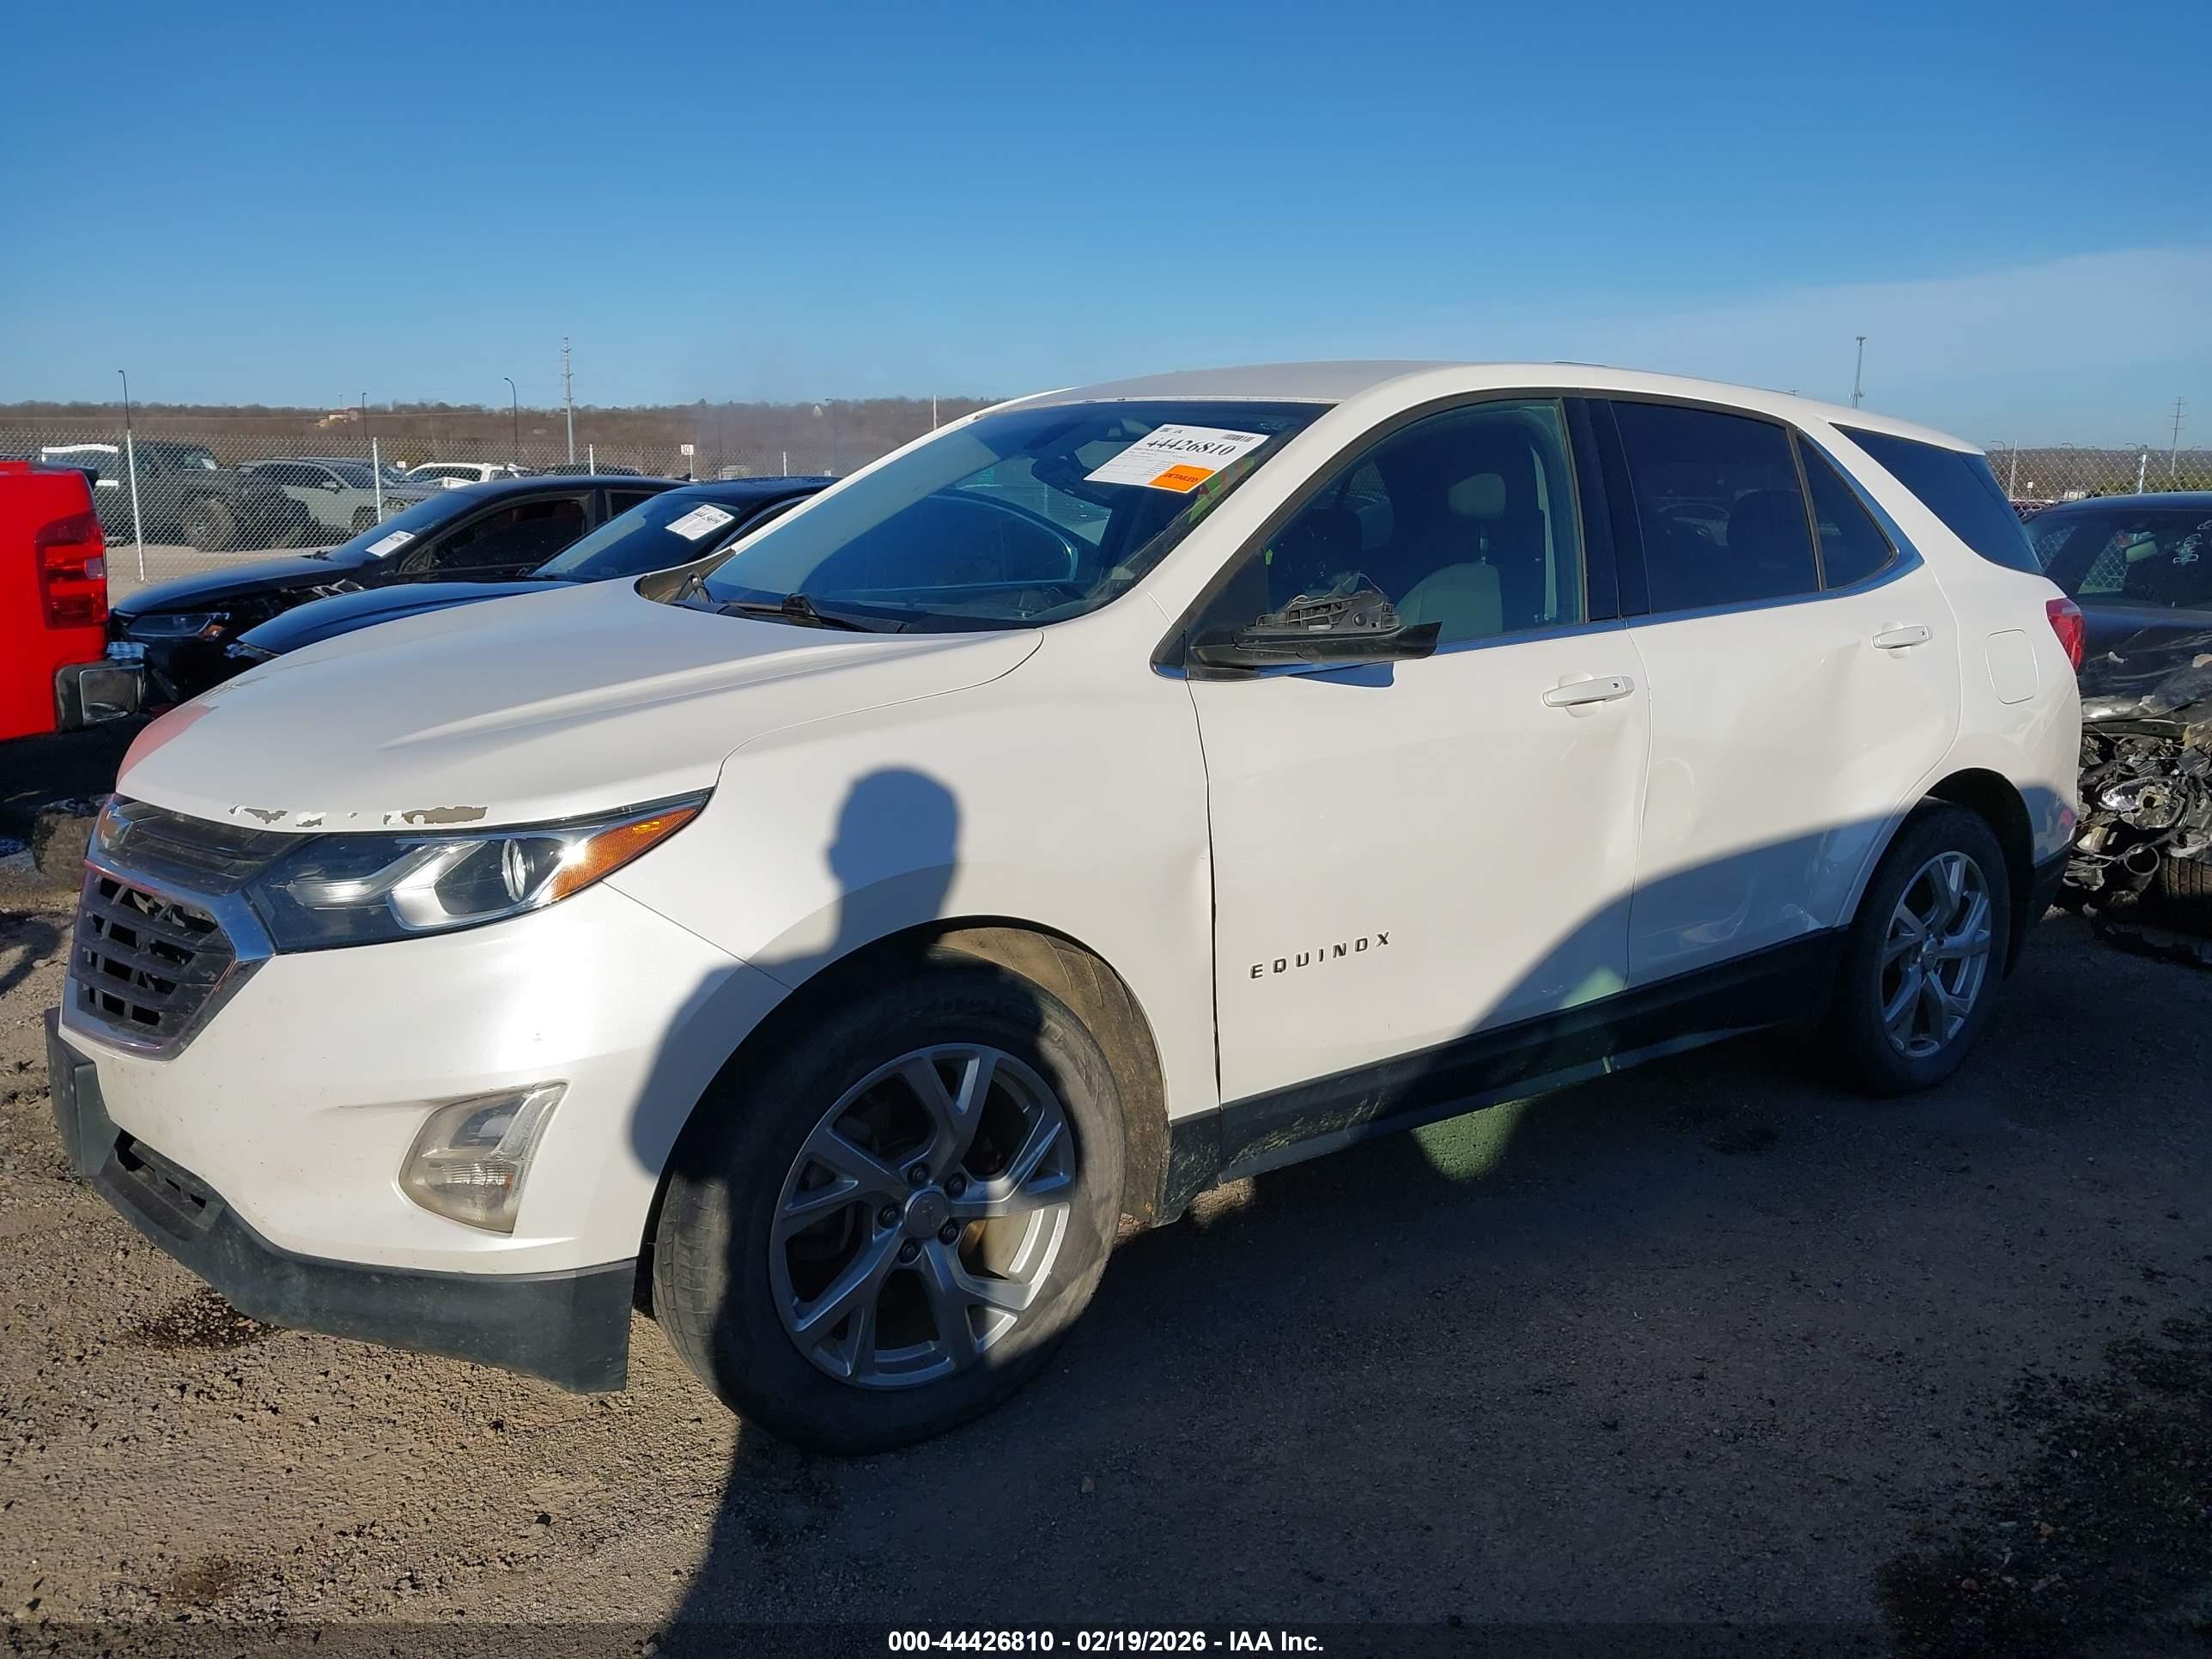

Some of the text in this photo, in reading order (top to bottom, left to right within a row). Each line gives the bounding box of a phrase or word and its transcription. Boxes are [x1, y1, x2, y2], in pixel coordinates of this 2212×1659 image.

[1146, 438, 1237, 456] 44426810
[1164, 472, 1199, 483] DETAILED
[1250, 932, 1389, 979] EQUINOX
